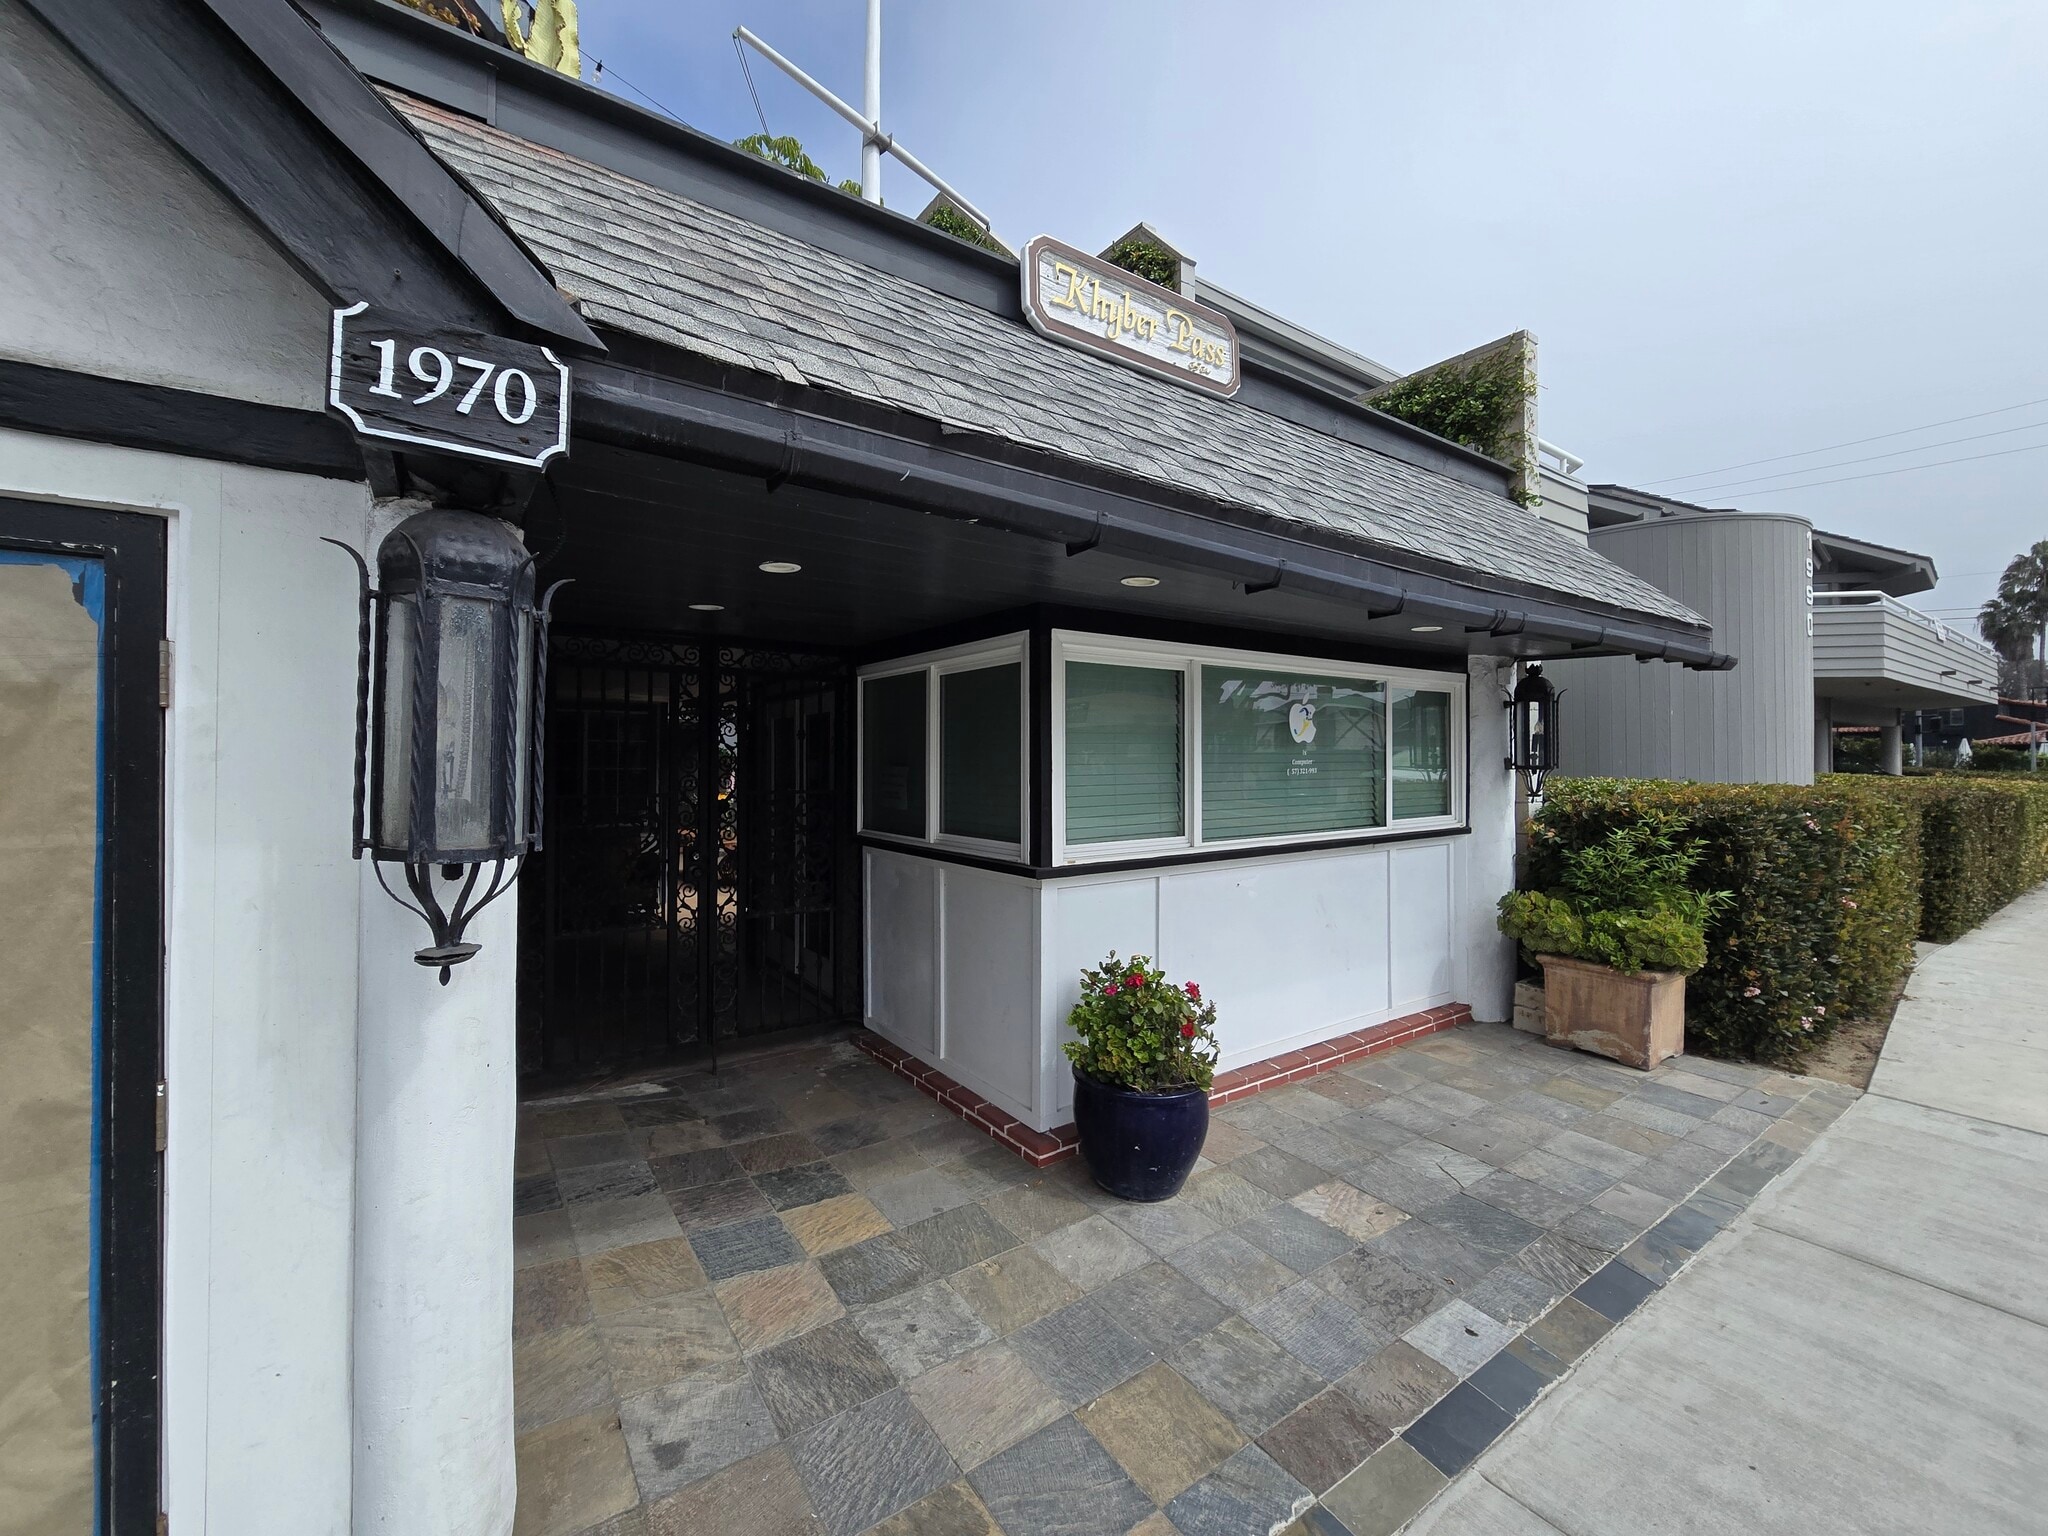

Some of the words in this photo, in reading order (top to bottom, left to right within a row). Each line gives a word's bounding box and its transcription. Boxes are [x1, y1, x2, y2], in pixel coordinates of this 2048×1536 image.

[1051, 262, 1158, 340] Khyber
[1166, 307, 1226, 367] Pass
[368, 338, 537, 425] 1970
[1806, 531, 1814, 637] 1990
